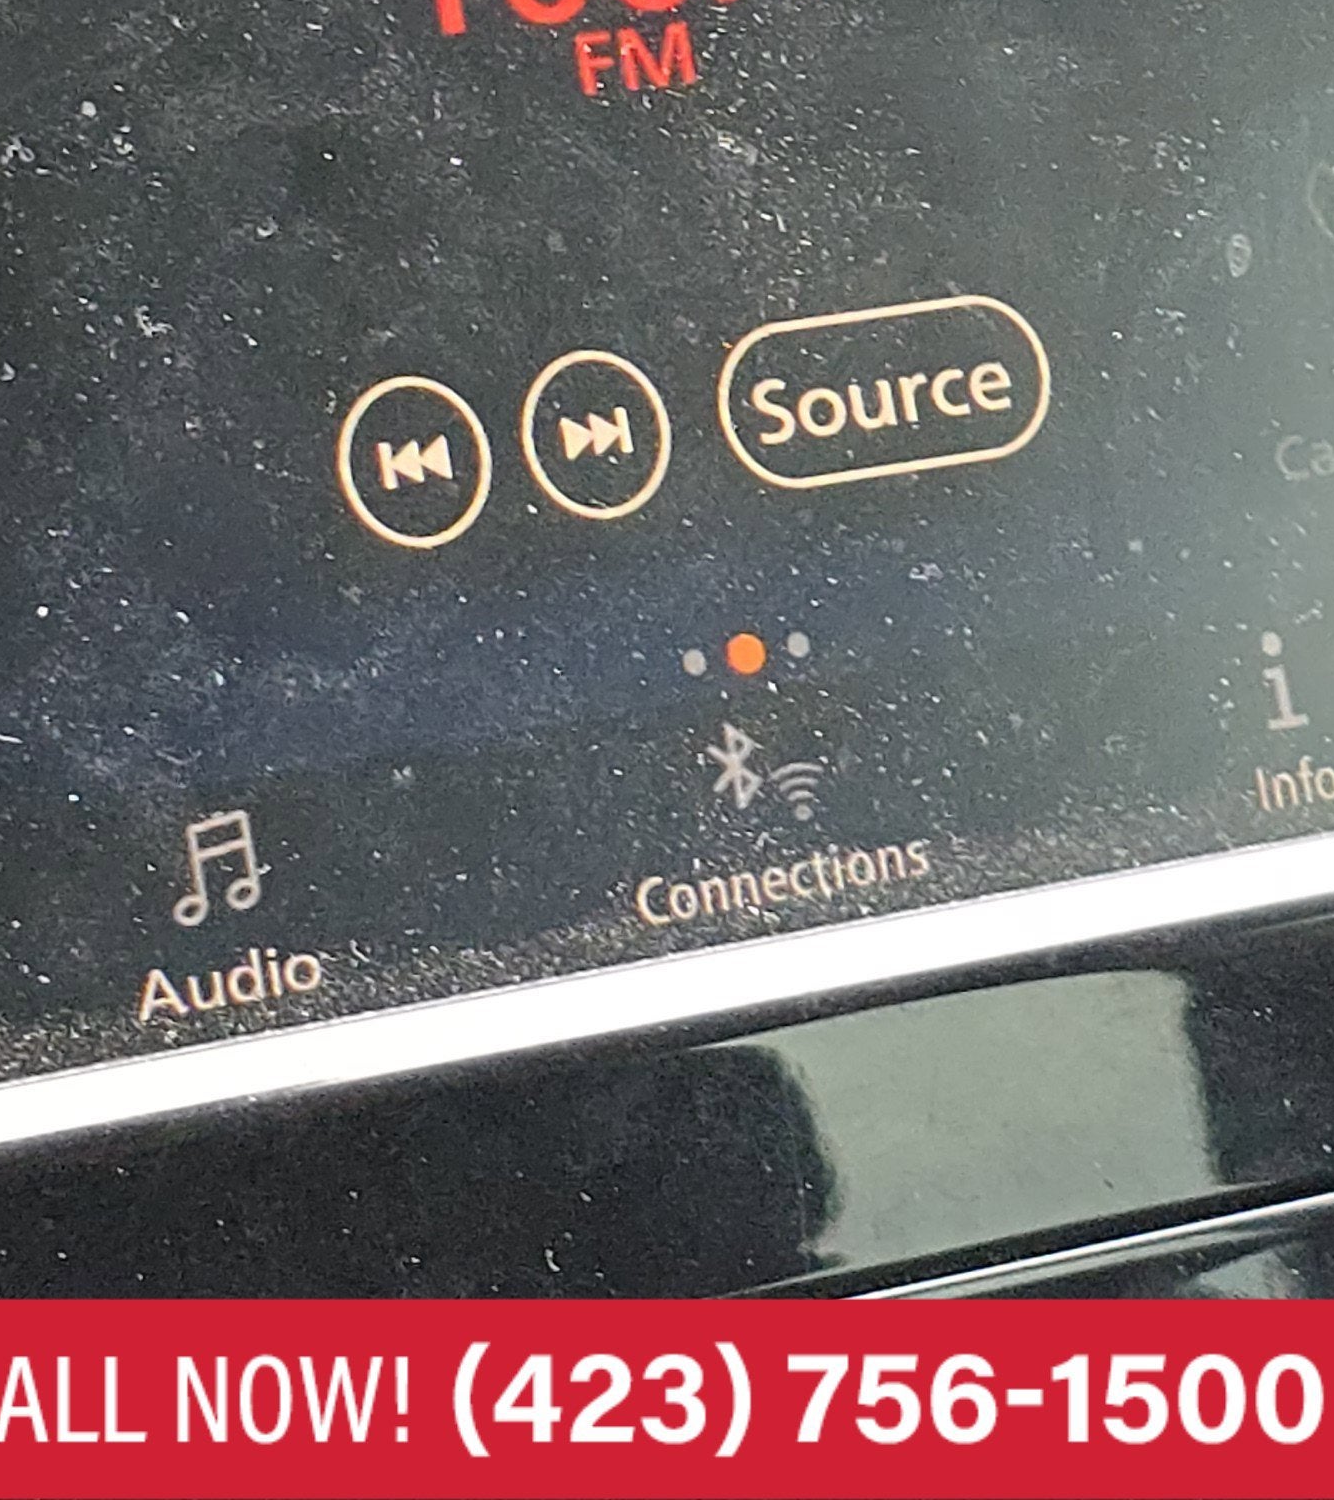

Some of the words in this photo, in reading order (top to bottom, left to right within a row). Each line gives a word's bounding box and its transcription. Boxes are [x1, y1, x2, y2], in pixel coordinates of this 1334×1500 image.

[572, 20, 698, 97] FM
[750, 359, 1014, 446] Source
[635, 837, 930, 926] Connections
[137, 947, 322, 1023] Audio
